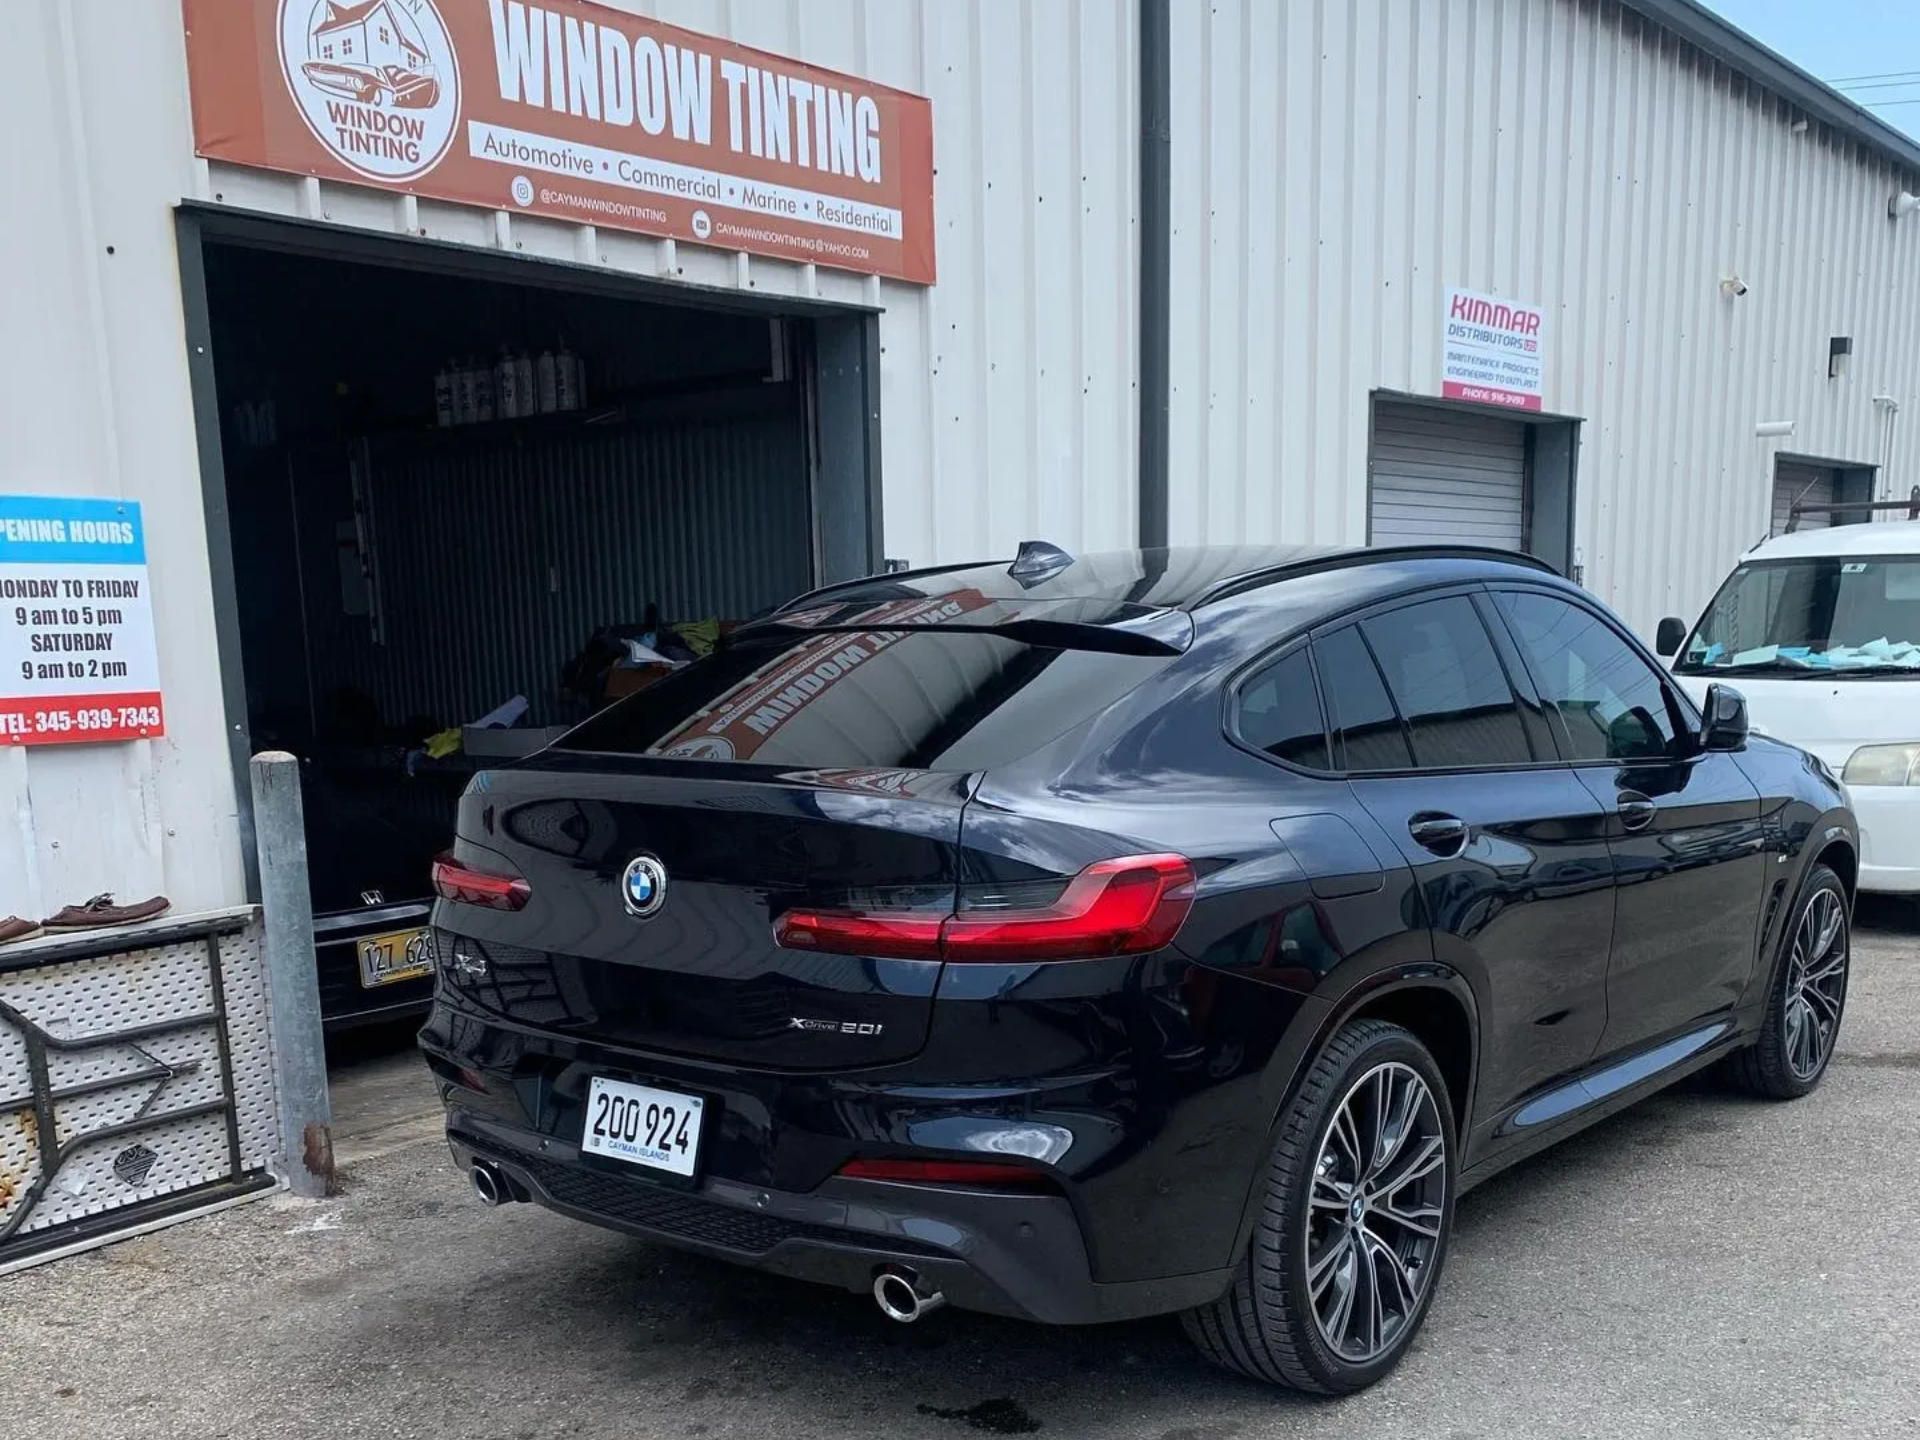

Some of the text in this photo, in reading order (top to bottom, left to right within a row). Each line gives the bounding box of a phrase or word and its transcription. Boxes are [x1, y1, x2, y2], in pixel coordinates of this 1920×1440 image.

[488, 0, 881, 184] WINDOW TINTING
[326, 100, 425, 141] WINDOW
[336, 127, 420, 163] TINTING
[483, 132, 893, 233] Automotive Commercial Marine Residential
[540, 189, 666, 223] @CAYMANWINDOWTINTING
[716, 222, 869, 259] CAYMANWINDOWTINTING@YAHOO.COM
[1450, 294, 1541, 336] KIMMAR
[1448, 323, 1523, 349] DISTRIBUTORS
[1495, 373, 1505, 383] TO
[1506, 376, 1538, 389] OUTLAST
[1502, 362, 1539, 376] PRODUCTS
[1462, 387, 1491, 402] PHONE
[69, 520, 133, 544] HOURS
[62, 580, 83, 598] TO
[88, 580, 139, 598] FRIDAY
[15, 606, 122, 626] 9 am to 5 pm
[31, 633, 113, 652] SATURDAY
[22, 659, 127, 680] 9 am to 2 pm
[0, 706, 159, 734] TEL: 345-939-7343
[364, 942, 393, 974] 127
[593, 1092, 691, 1155] 200 924
[608, 1139, 637, 1154] CAYMAN
[639, 1146, 671, 1161] ISLANDS
